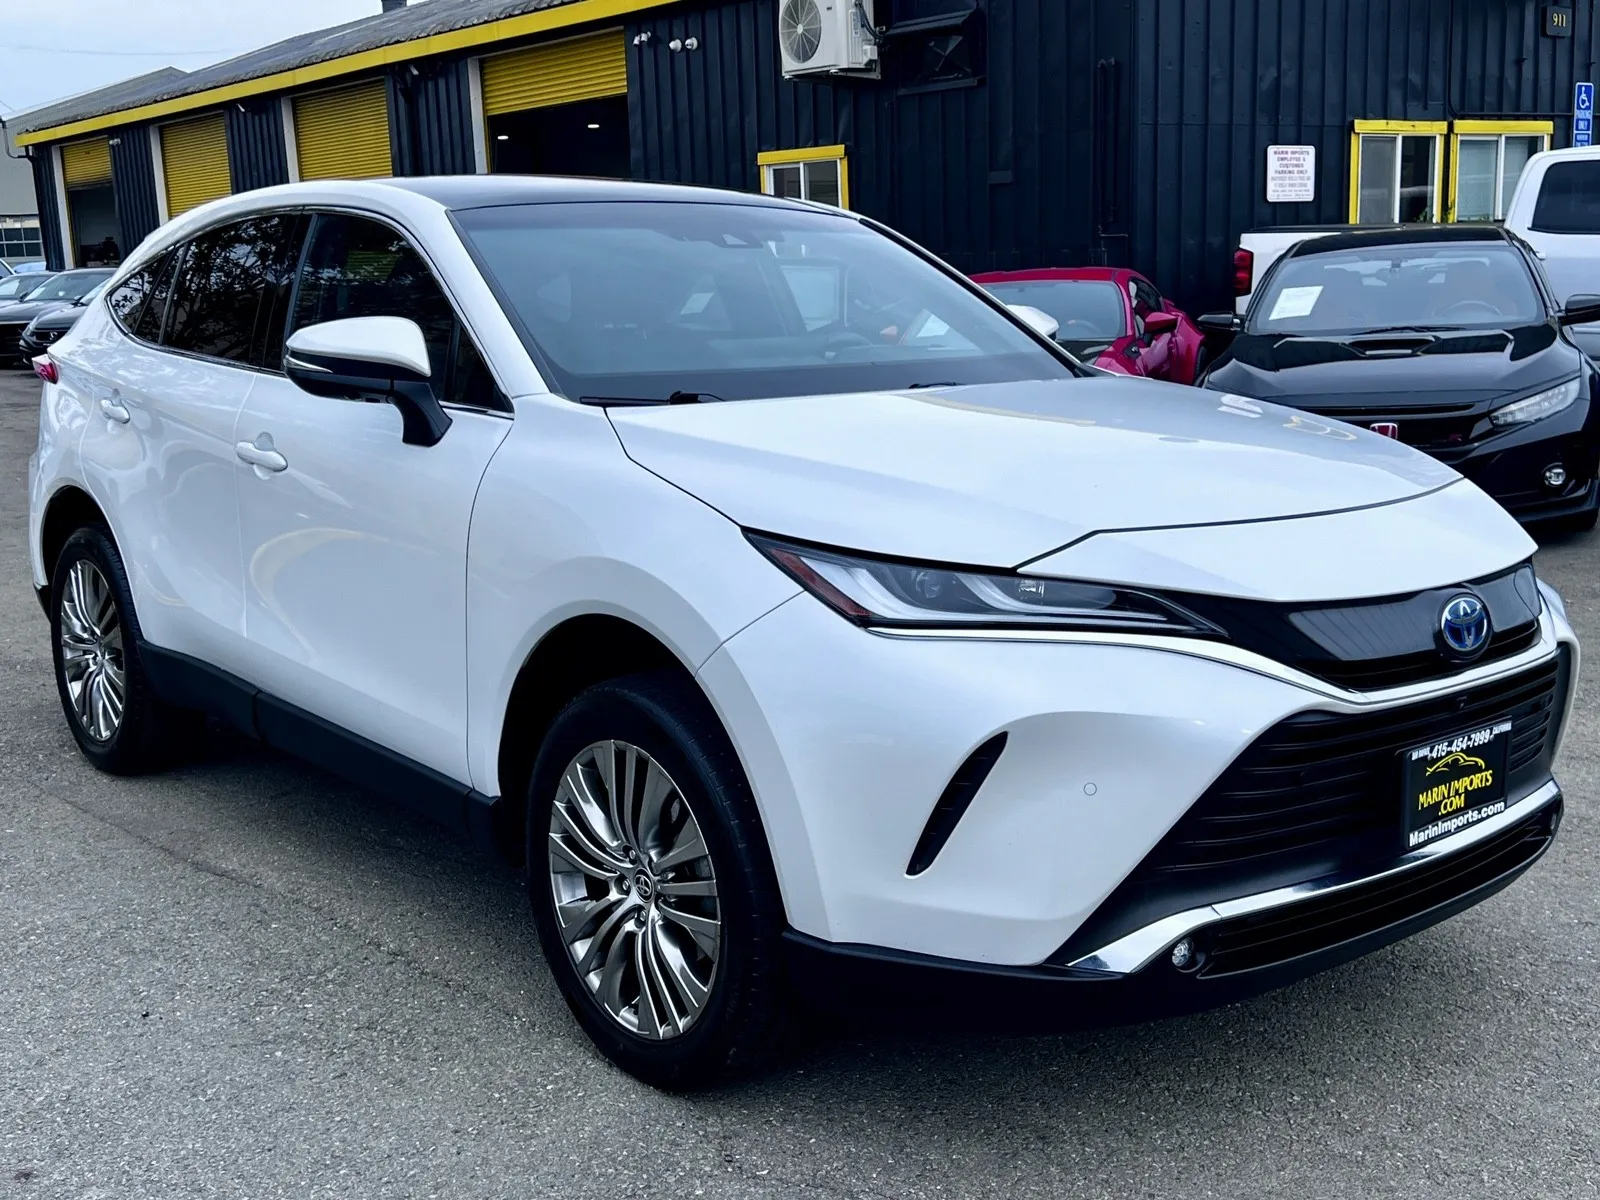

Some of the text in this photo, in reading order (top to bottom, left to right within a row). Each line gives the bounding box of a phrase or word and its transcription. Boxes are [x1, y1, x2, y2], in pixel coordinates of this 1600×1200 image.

[1552, 13, 1566, 27] 911
[1431, 729, 1491, 759] 415-454-7999
[1418, 769, 1493, 811] MARIN IMPORTS
[1438, 793, 1465, 816] .COM
